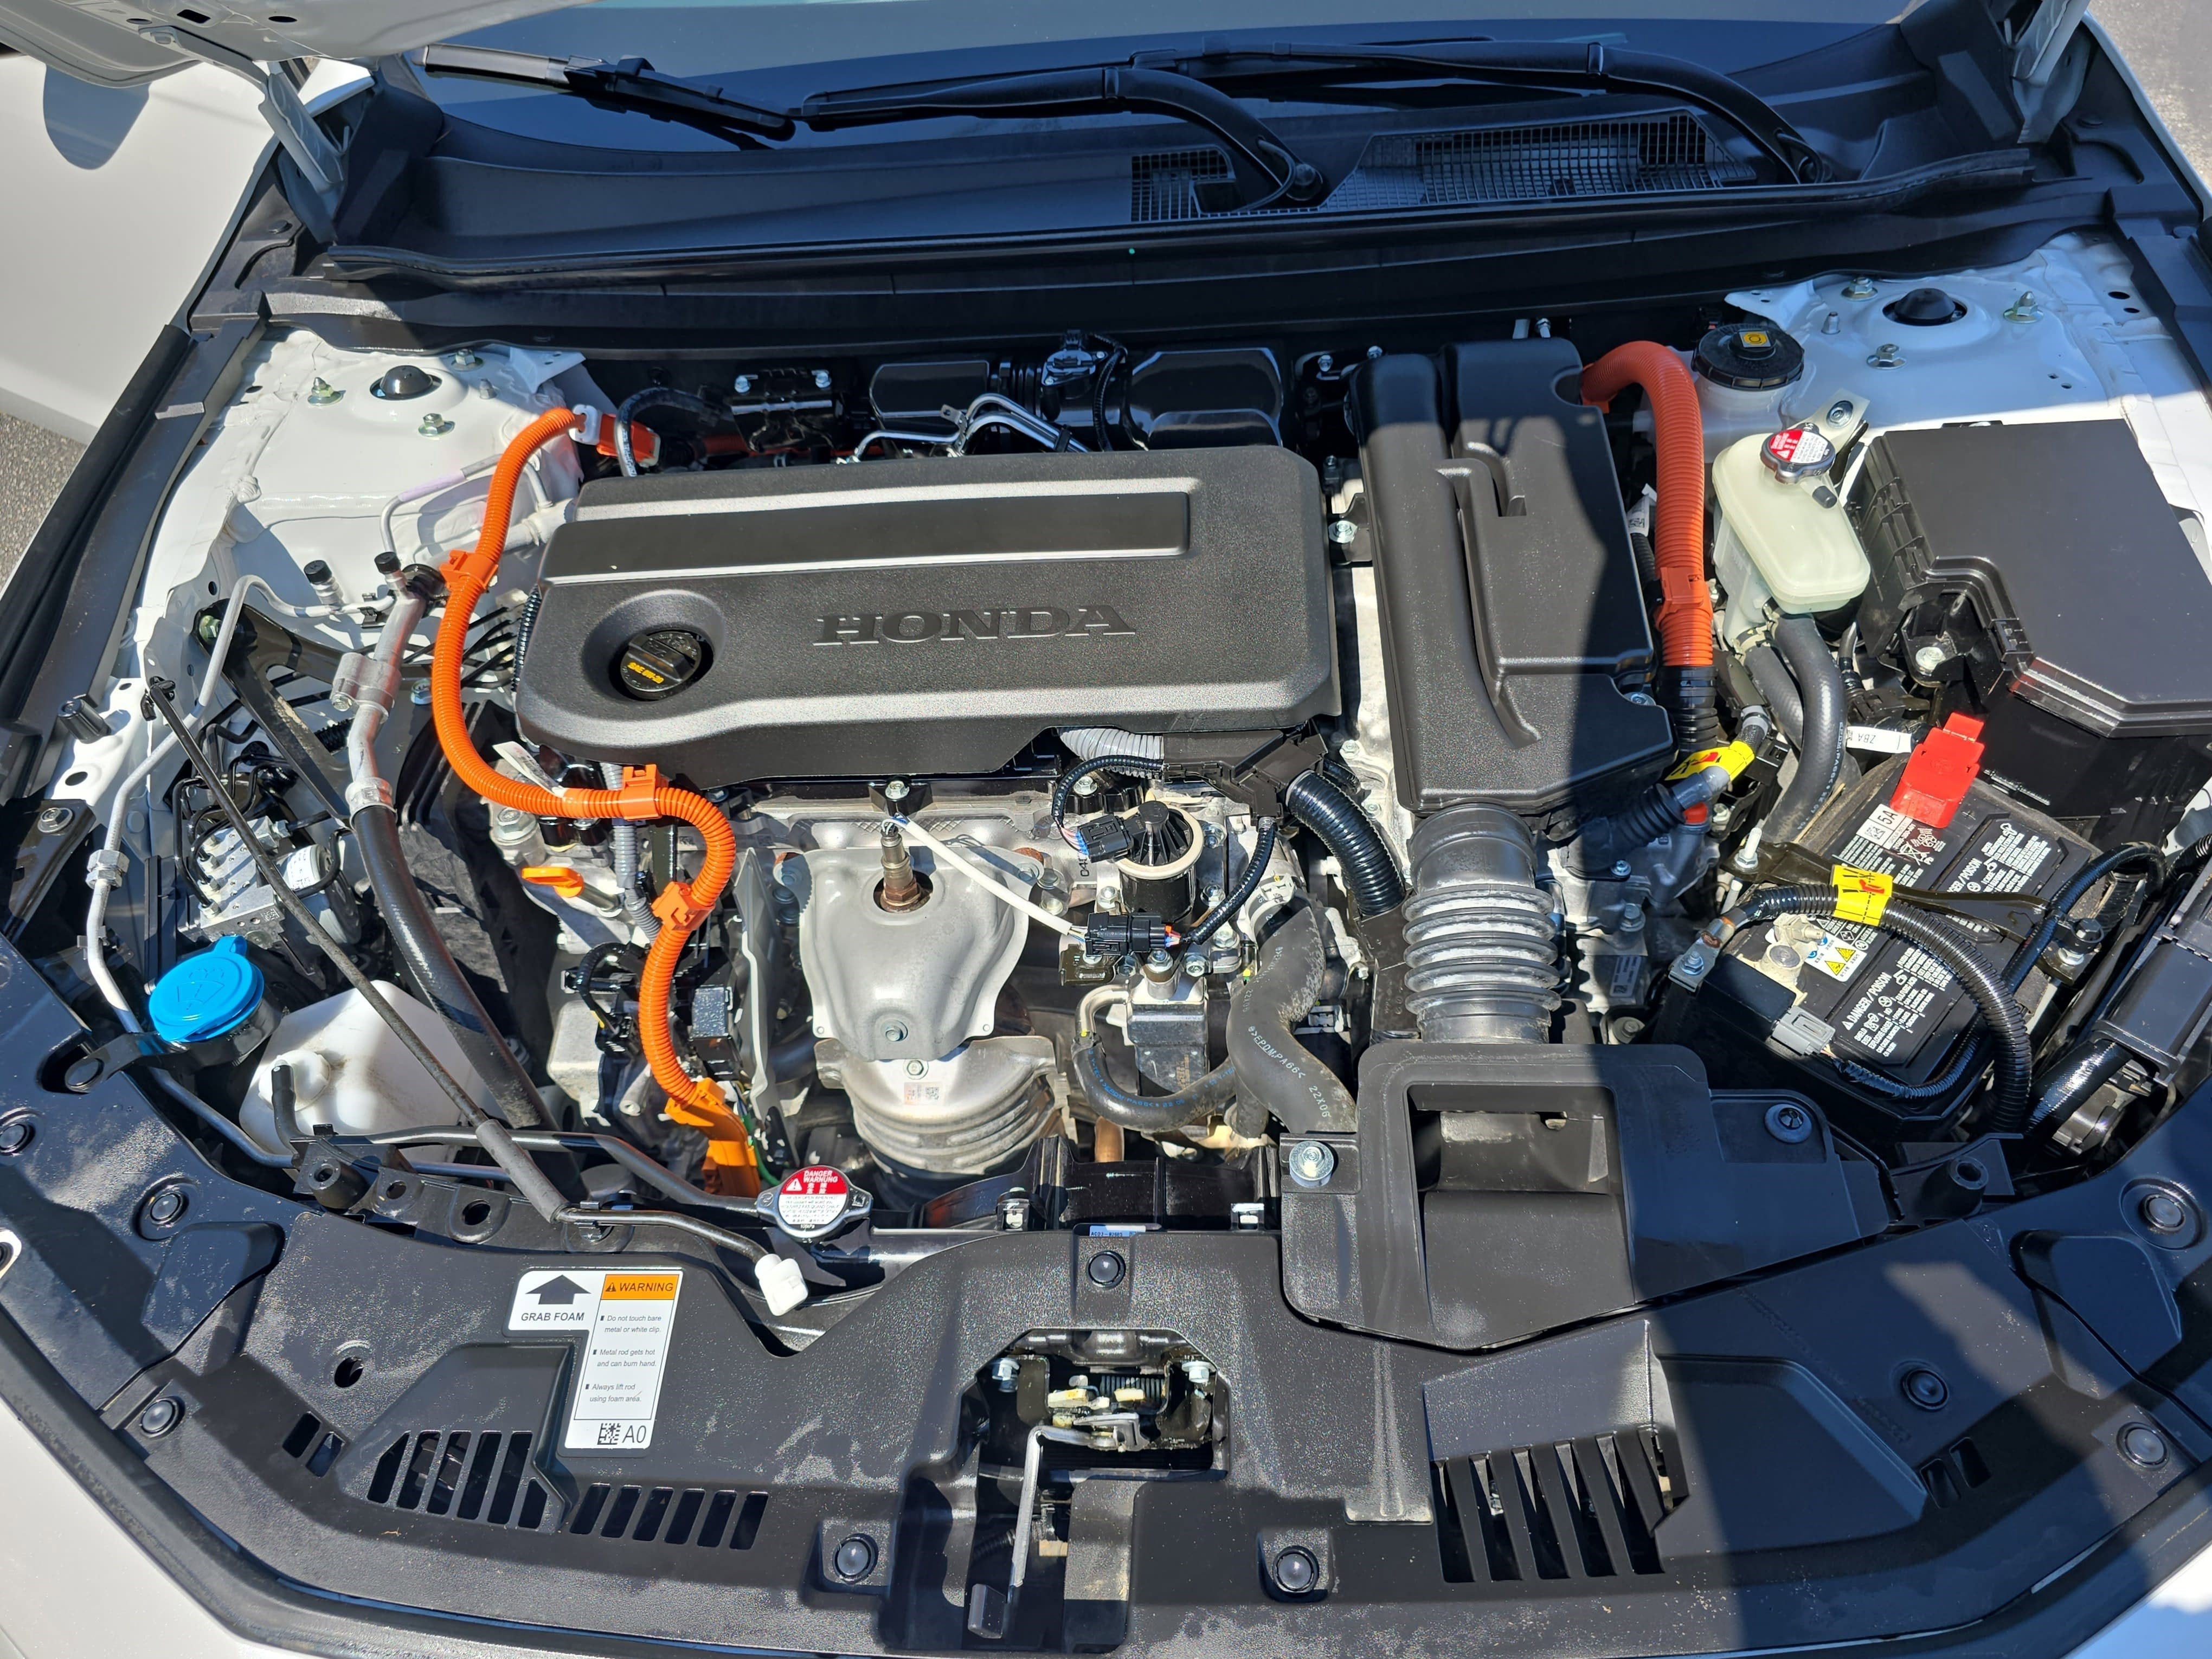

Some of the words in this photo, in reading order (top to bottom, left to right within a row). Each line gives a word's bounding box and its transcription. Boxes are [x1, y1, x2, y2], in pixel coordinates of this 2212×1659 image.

[813, 605, 1136, 646] HONDA
[627, 662, 645, 673] SAE
[1877, 810, 1898, 824] 5A
[1309, 1086, 1332, 1118] 22X06
[620, 1283, 673, 1292] WARNING
[521, 1313, 551, 1321] GRAB
[554, 1313, 585, 1321] FOAM
[622, 1425, 647, 1443] A0
